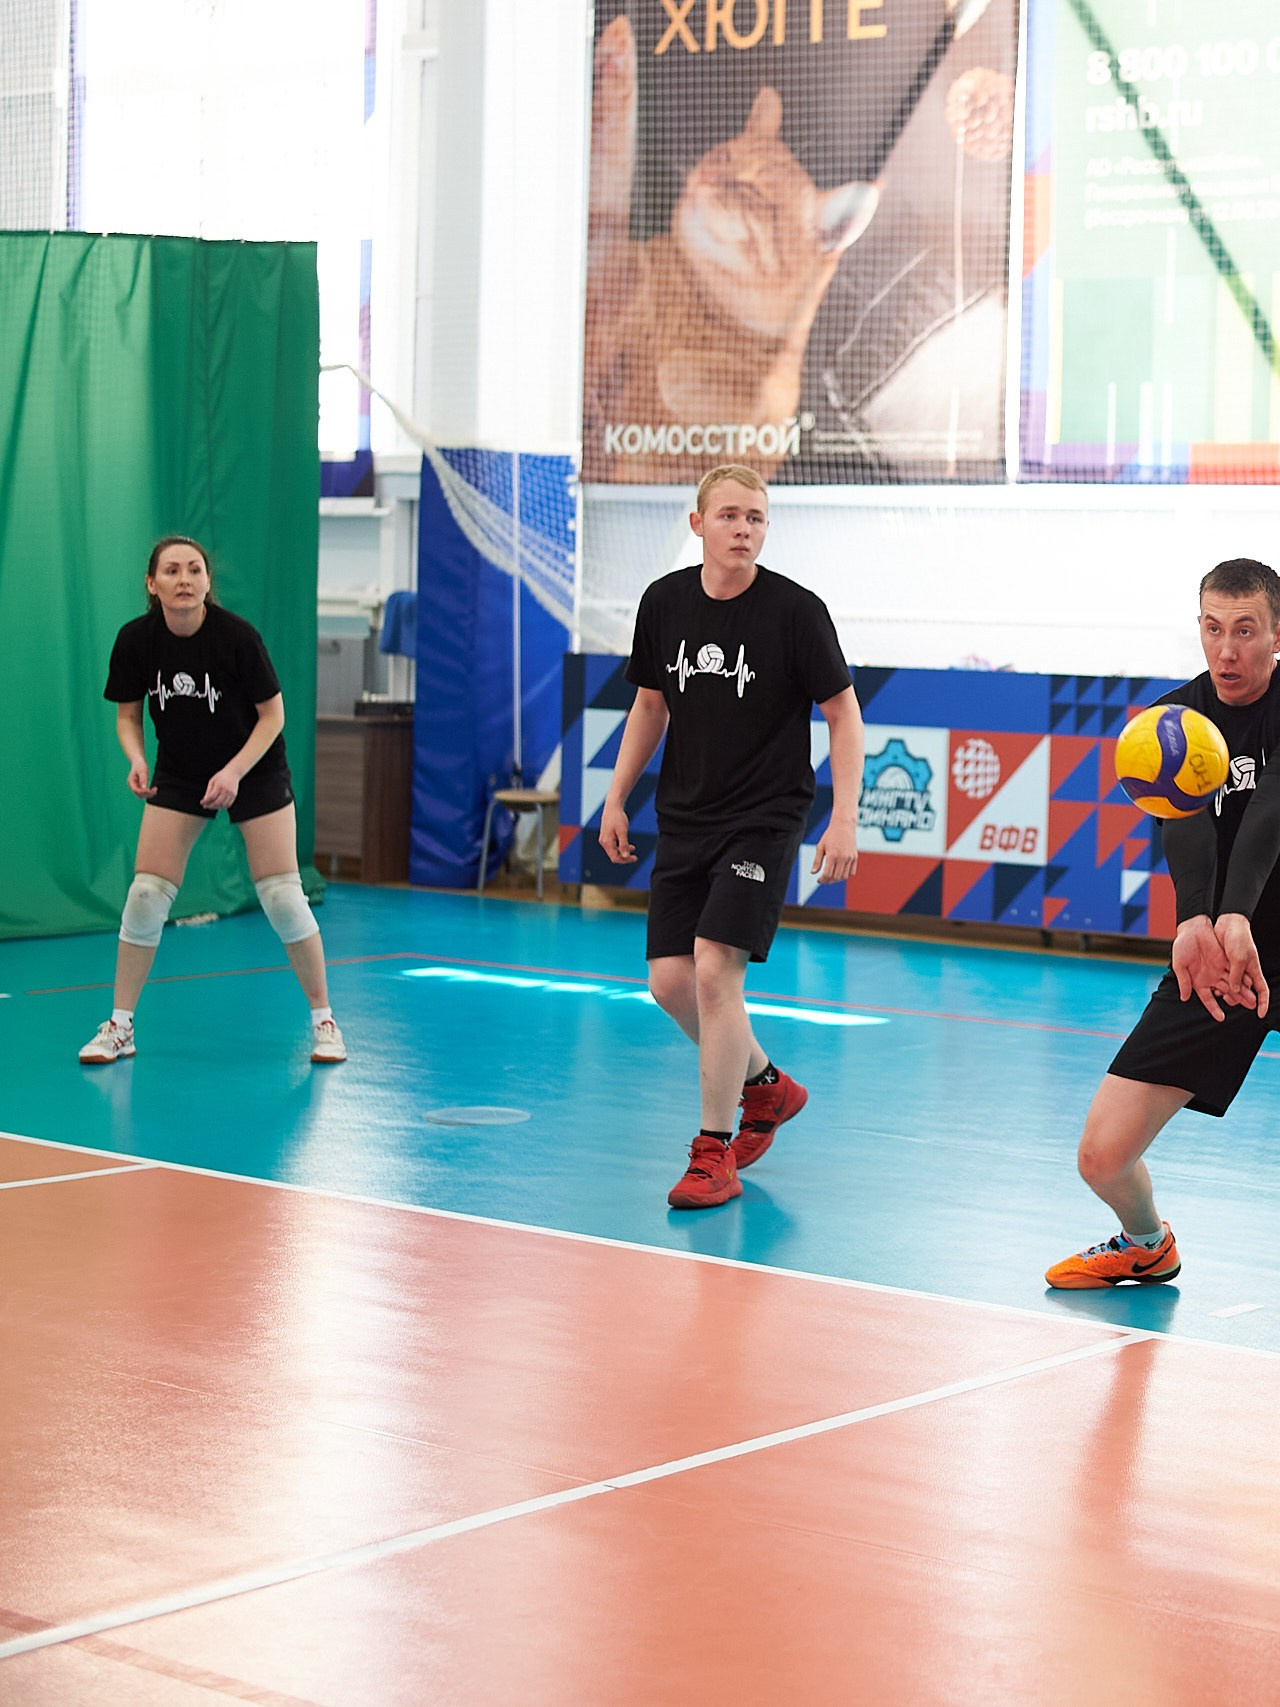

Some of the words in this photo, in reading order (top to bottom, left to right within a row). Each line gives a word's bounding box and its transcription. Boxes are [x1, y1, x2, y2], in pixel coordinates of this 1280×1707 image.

[1086, 51, 1111, 84] 8
[1118, 45, 1188, 81] 800
[1195, 39, 1260, 78] 100
[1085, 96, 1202, 132] rshb.ru
[604, 417, 800, 457] КОМОССТРОЙ
[980, 824, 1039, 853] ВФВ
